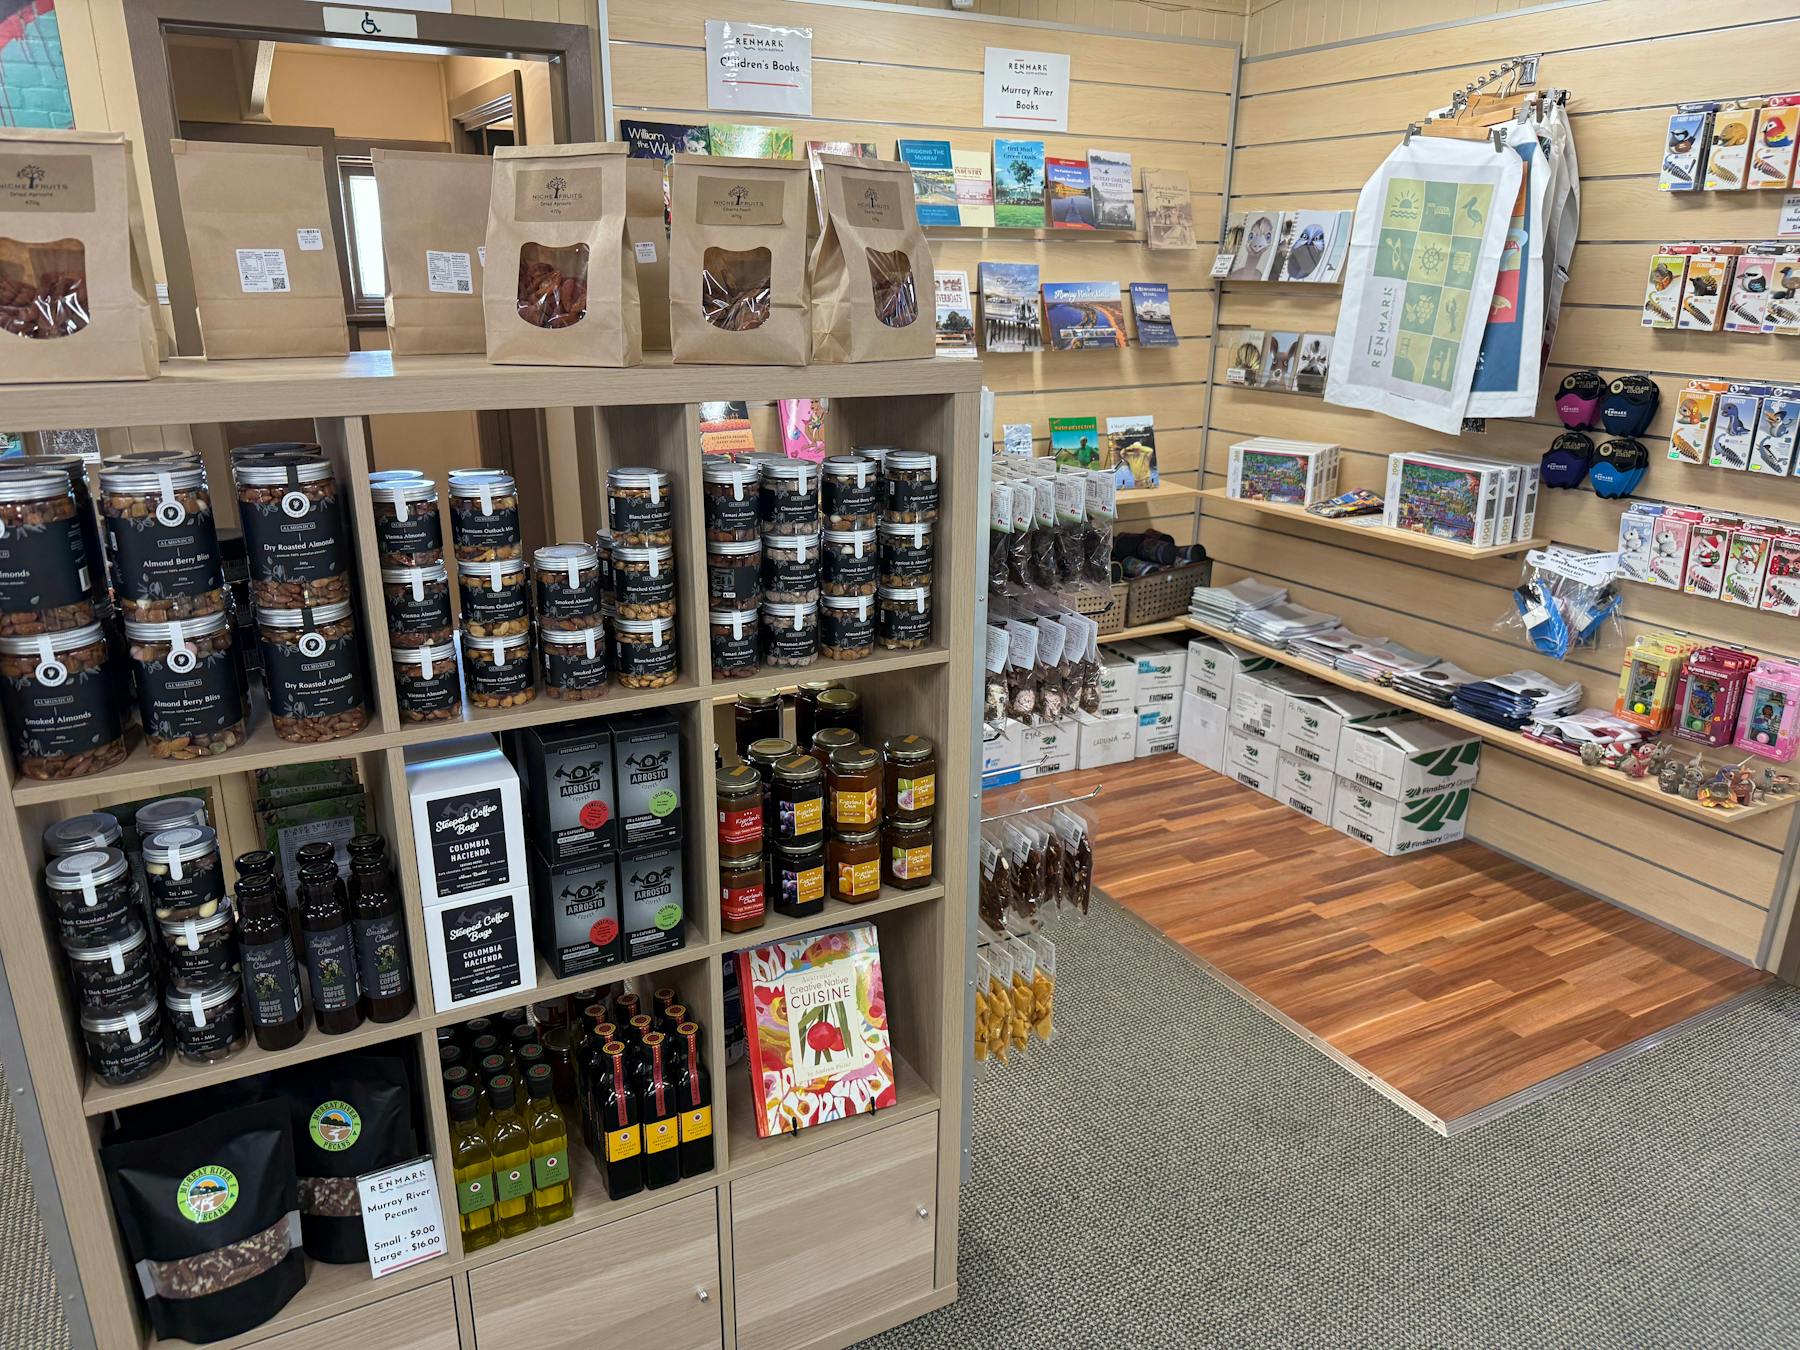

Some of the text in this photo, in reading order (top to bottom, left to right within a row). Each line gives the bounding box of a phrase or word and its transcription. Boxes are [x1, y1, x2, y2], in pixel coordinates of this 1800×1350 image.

[735, 37, 784, 48] RENMARK
[772, 61, 800, 72] Books
[1008, 62, 1048, 72] RENMARK
[1001, 84, 1054, 97] Murray River
[1016, 100, 1039, 111] Books
[627, 127, 665, 142] William
[637, 140, 675, 155] the Wild
[905, 147, 932, 155] BRIDGING
[741, 200, 764, 208] FRUITS
[936, 292, 963, 304] IVERBOATS
[1371, 287, 1393, 368] RENMARK
[263, 538, 335, 552] Dry Roasted Almonds
[143, 553, 210, 568] Almond Berry Bliss
[0, 569, 30, 578] lmonds
[421, 609, 442, 617] Almonds
[284, 673, 353, 690] Dry Roasted Almonds
[153, 693, 221, 708] Almond Berry Bliss
[425, 689, 448, 697] Almonds
[25, 711, 92, 726] Smoked Almonds
[631, 769, 667, 783] ARROSTO
[562, 780, 599, 796] ARROSTO
[1422, 776, 1478, 795] Finsbury Green
[435, 803, 498, 833] Steeped Coffee
[455, 821, 480, 836] Bags
[449, 838, 490, 853] COLOMBIA
[1411, 831, 1462, 850] Finsbury Green
[450, 848, 491, 862] HACIENDA
[636, 885, 670, 900] ARROSTO
[567, 900, 603, 915] ARROSTO
[449, 911, 510, 941] Steeped Coffee
[468, 928, 493, 943] Bags
[462, 944, 503, 960] COLOMBIA
[464, 953, 503, 968] HACIENDA
[379, 975, 400, 986] COFFEE
[789, 976, 849, 995] Creative Native
[102, 983, 131, 995] Chocolate
[323, 989, 346, 998] COFFEE
[790, 984, 851, 1009] CUISINE
[259, 1004, 283, 1013] COFFEE
[120, 1050, 148, 1065] Chocolate
[312, 1101, 359, 1121] MURRAY RIVER
[322, 1139, 351, 1150] PECANS
[180, 1165, 233, 1194] MURRAY RIVER
[370, 1169, 427, 1193] RENMARK
[367, 1188, 431, 1214] Murray River
[384, 1205, 418, 1222] Pecans
[374, 1234, 401, 1251] Small
[410, 1224, 436, 1240] $9.00
[373, 1248, 402, 1264] Large
[411, 1236, 440, 1252] $16.00
